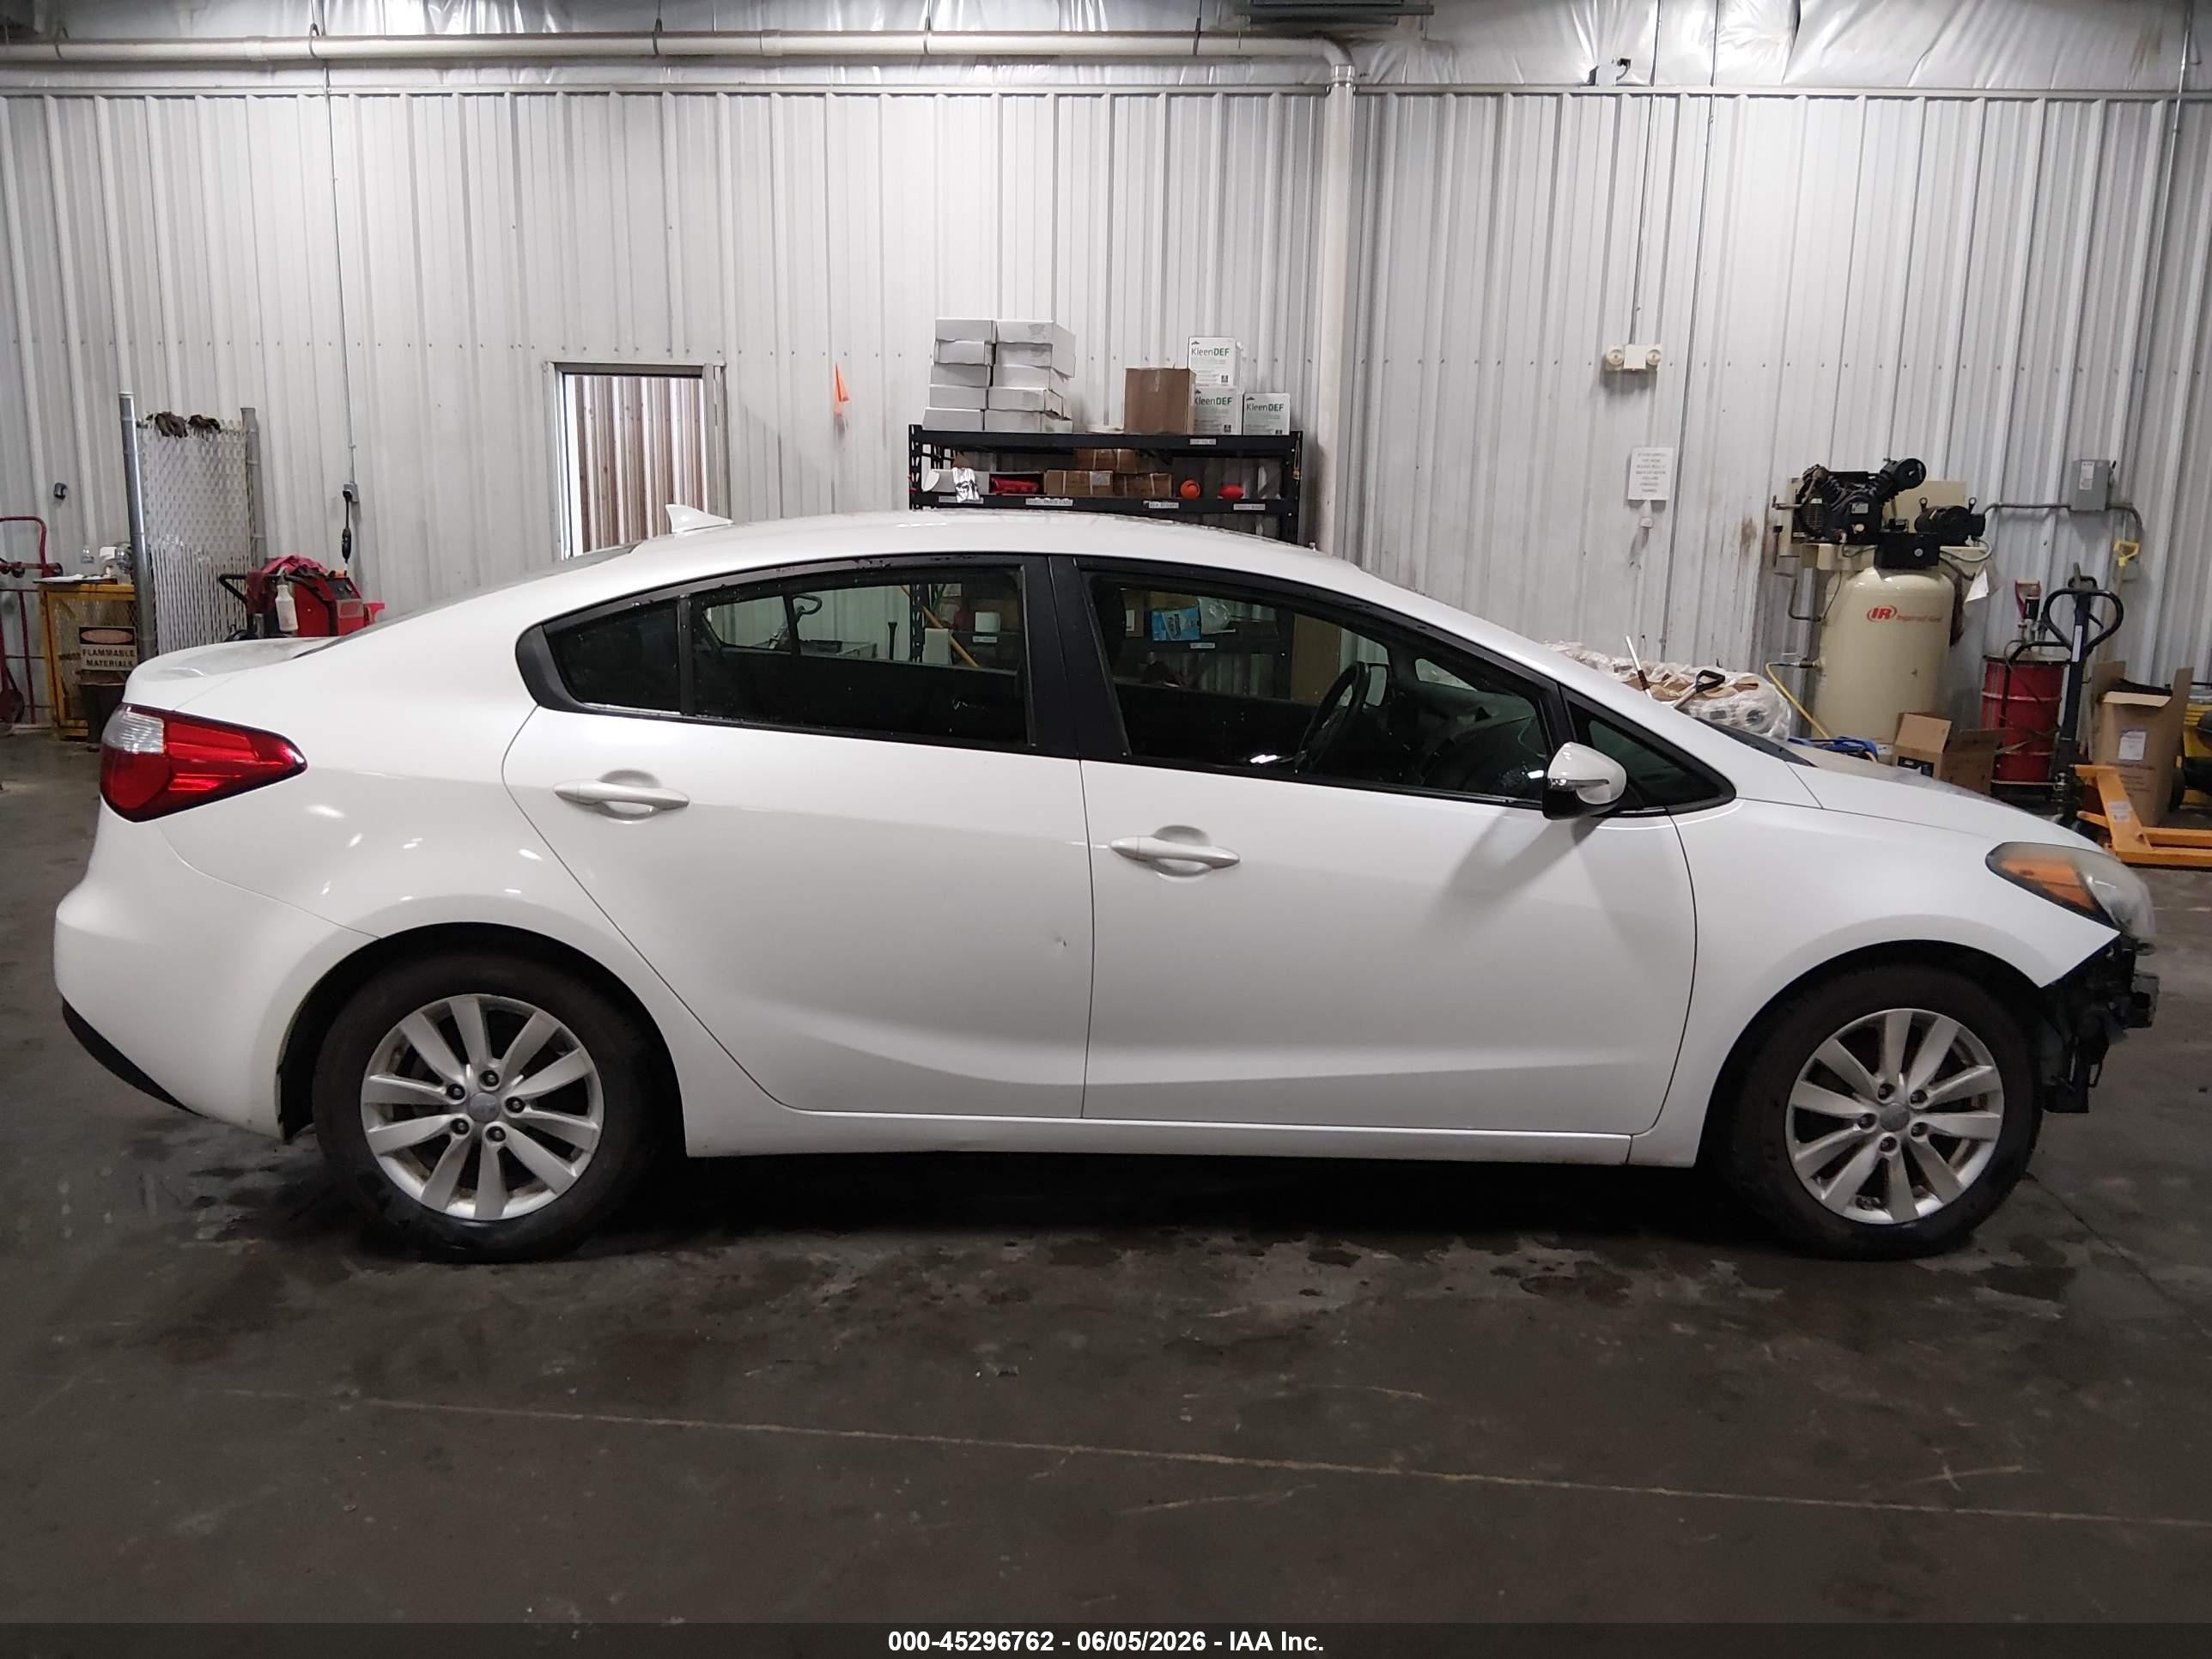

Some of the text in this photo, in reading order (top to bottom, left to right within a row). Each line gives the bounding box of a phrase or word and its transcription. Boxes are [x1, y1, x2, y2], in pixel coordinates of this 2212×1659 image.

[1191, 348, 1231, 356] KleenDEF
[1246, 404, 1285, 412] KleenDEF
[1871, 607, 1893, 620] IR
[82, 648, 136, 658] FLAMMABLE
[86, 659, 134, 667] MATERIALS
